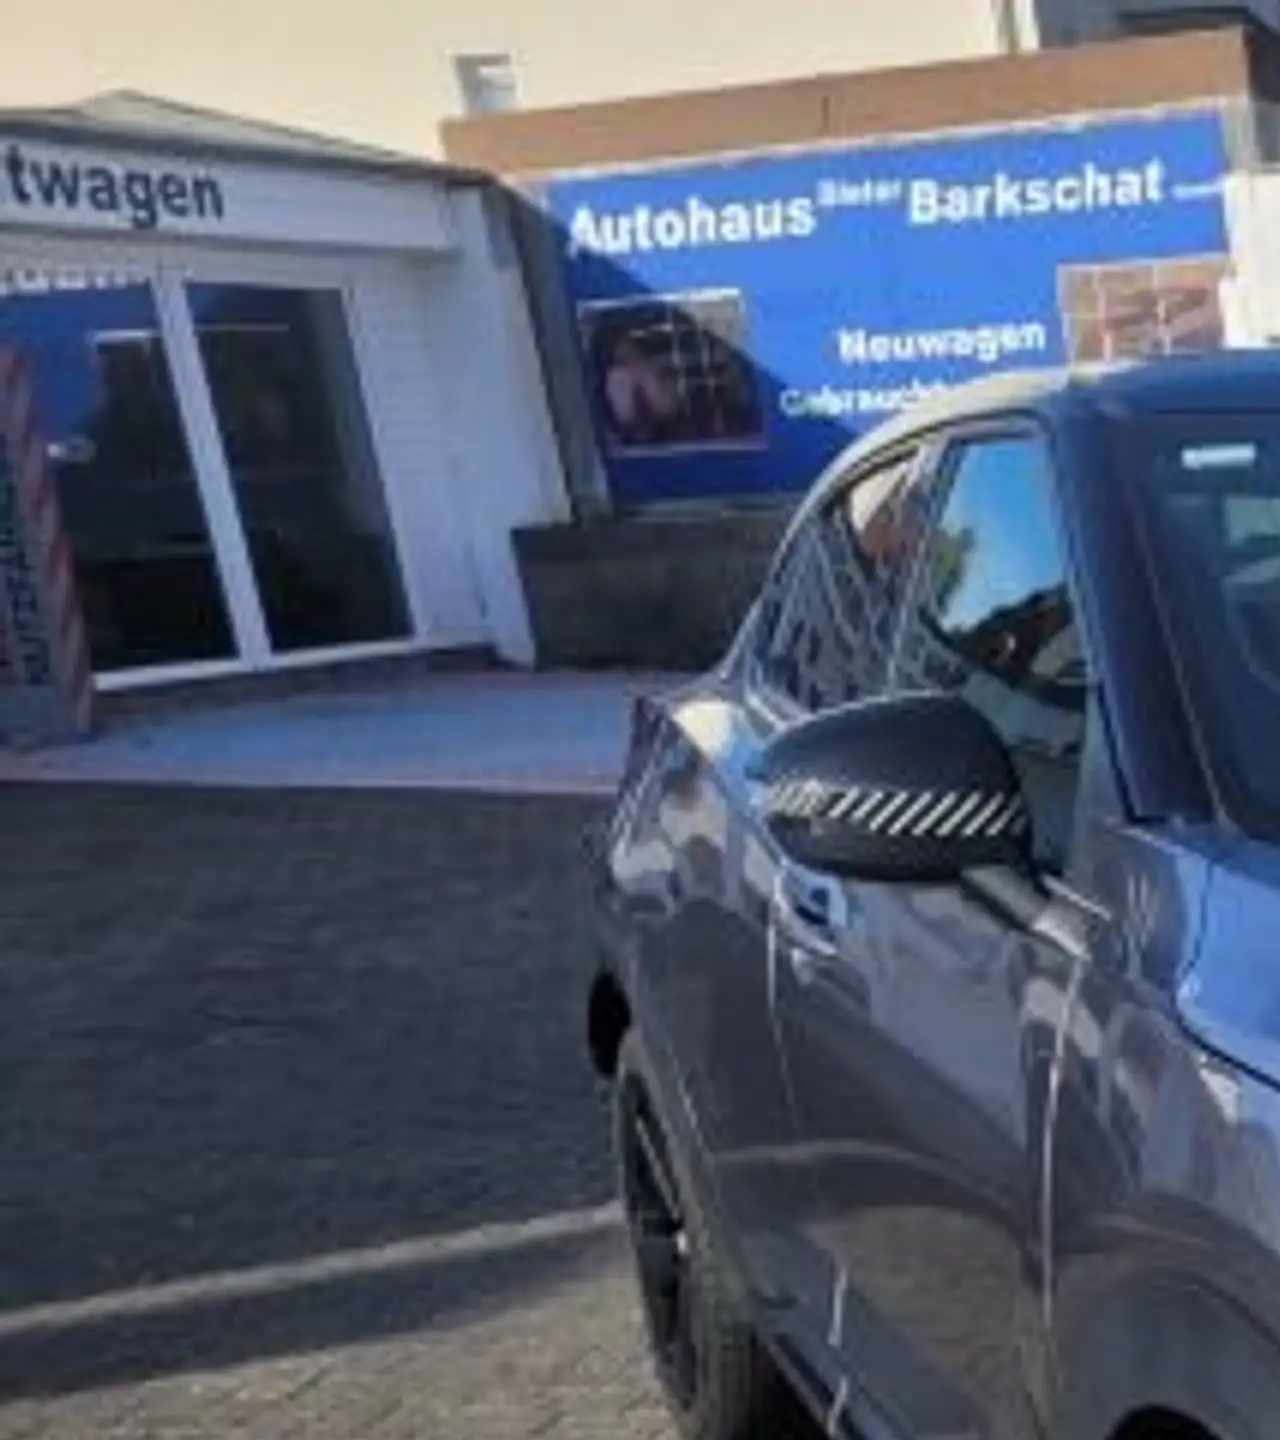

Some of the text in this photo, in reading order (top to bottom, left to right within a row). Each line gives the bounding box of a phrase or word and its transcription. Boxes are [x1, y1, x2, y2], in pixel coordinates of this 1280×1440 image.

[568, 192, 818, 255] Autohaus
[909, 157, 1165, 225] Barkschat
[837, 321, 1047, 364] Neuwagen
